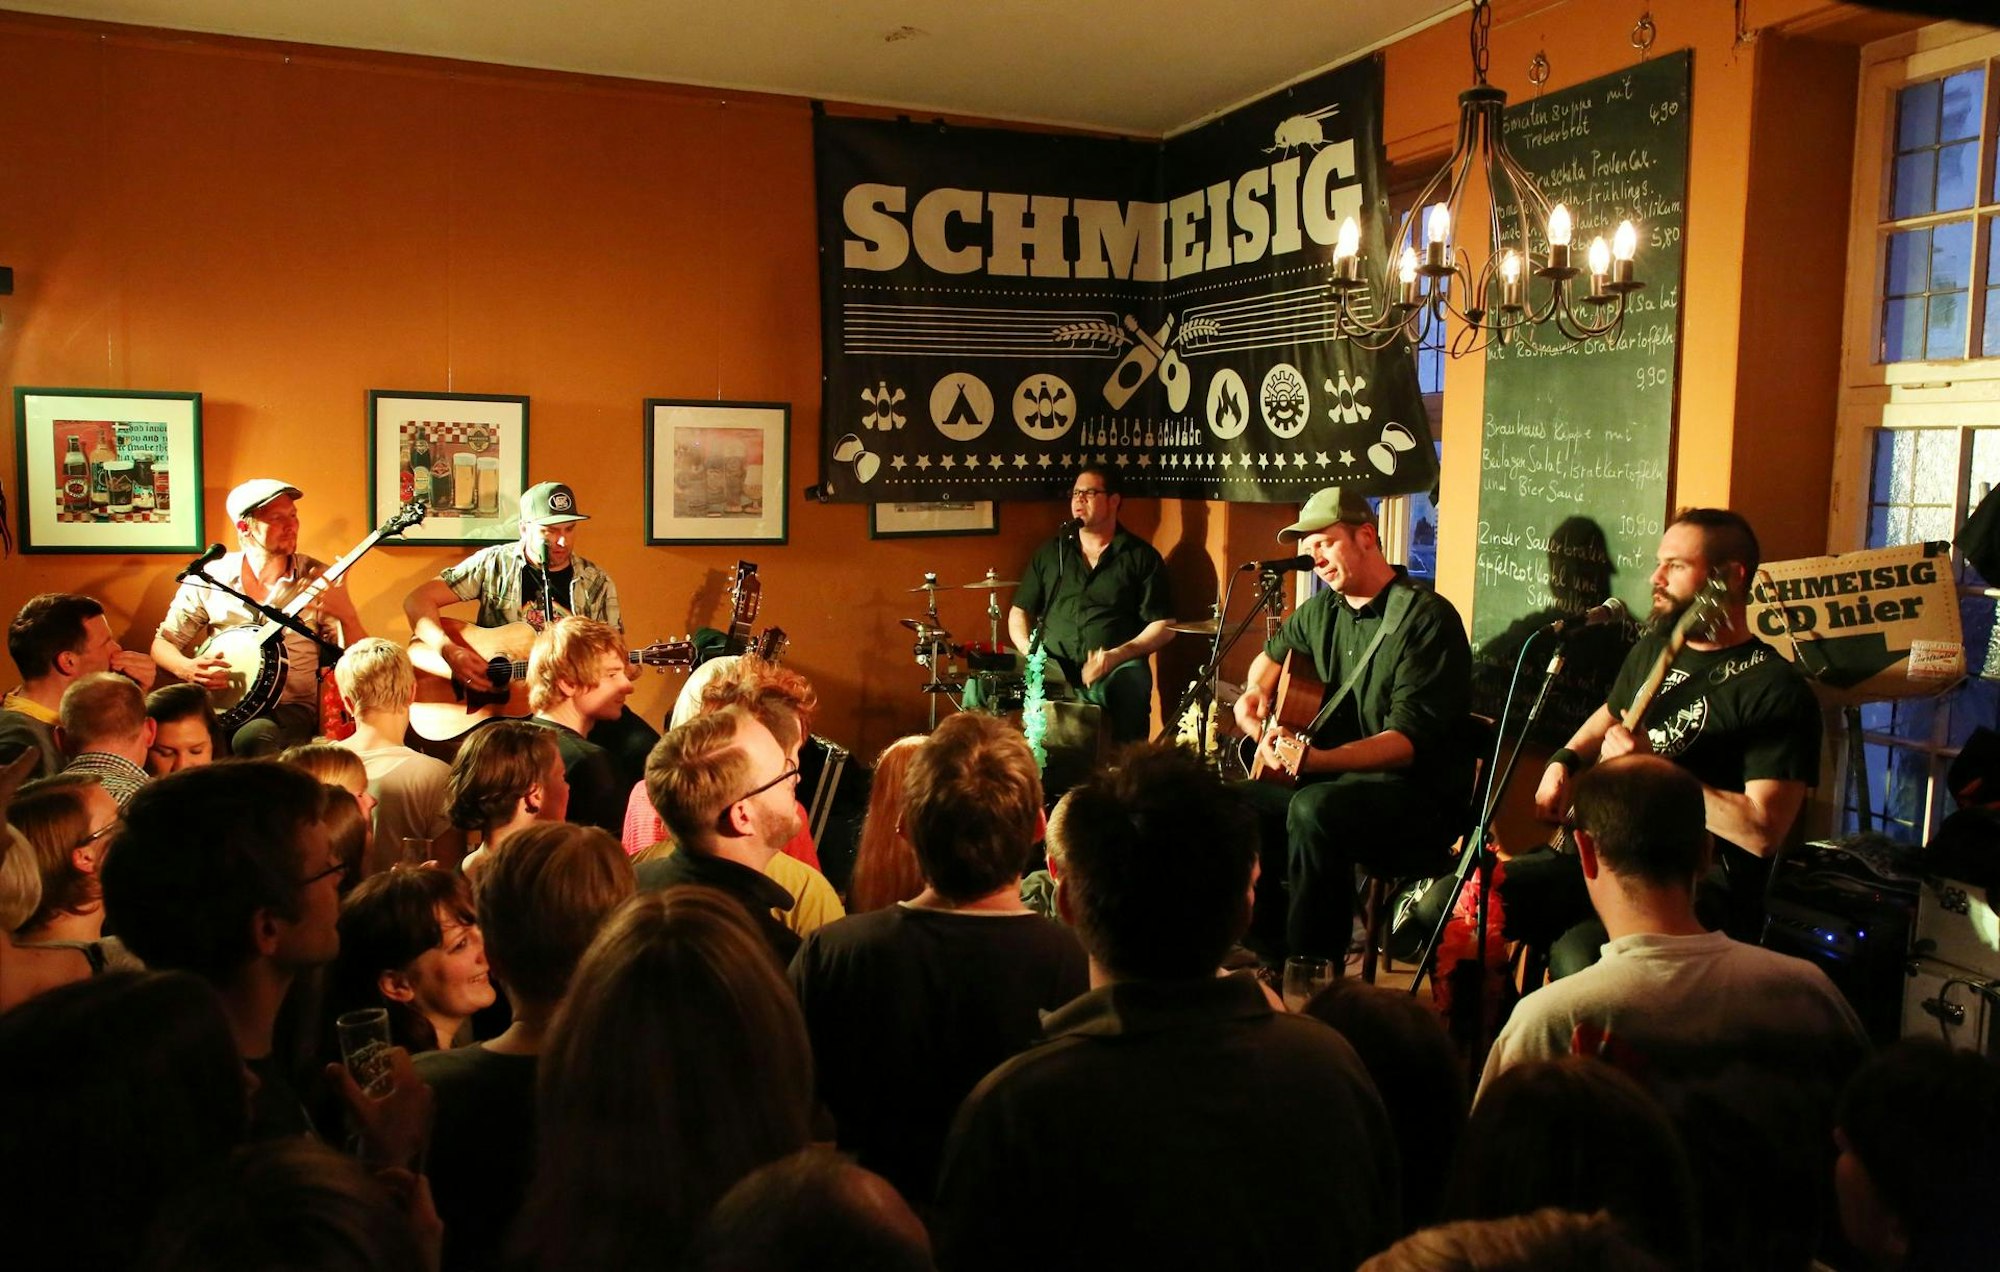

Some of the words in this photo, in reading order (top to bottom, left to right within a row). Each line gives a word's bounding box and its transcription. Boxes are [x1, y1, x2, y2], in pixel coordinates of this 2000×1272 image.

[1606, 75, 1633, 103] mit
[1650, 101, 1679, 125] 4,90
[842, 139, 1363, 282] SCHMEISIG
[1651, 227, 1680, 250] 5,80
[1635, 366, 1667, 391] 9,90
[1618, 514, 1659, 538] 10,90
[1747, 561, 1937, 605] CHMEISIG
[1757, 604, 1817, 637] CD
[1825, 595, 1923, 630] hier
[1708, 650, 1768, 685] Raki
